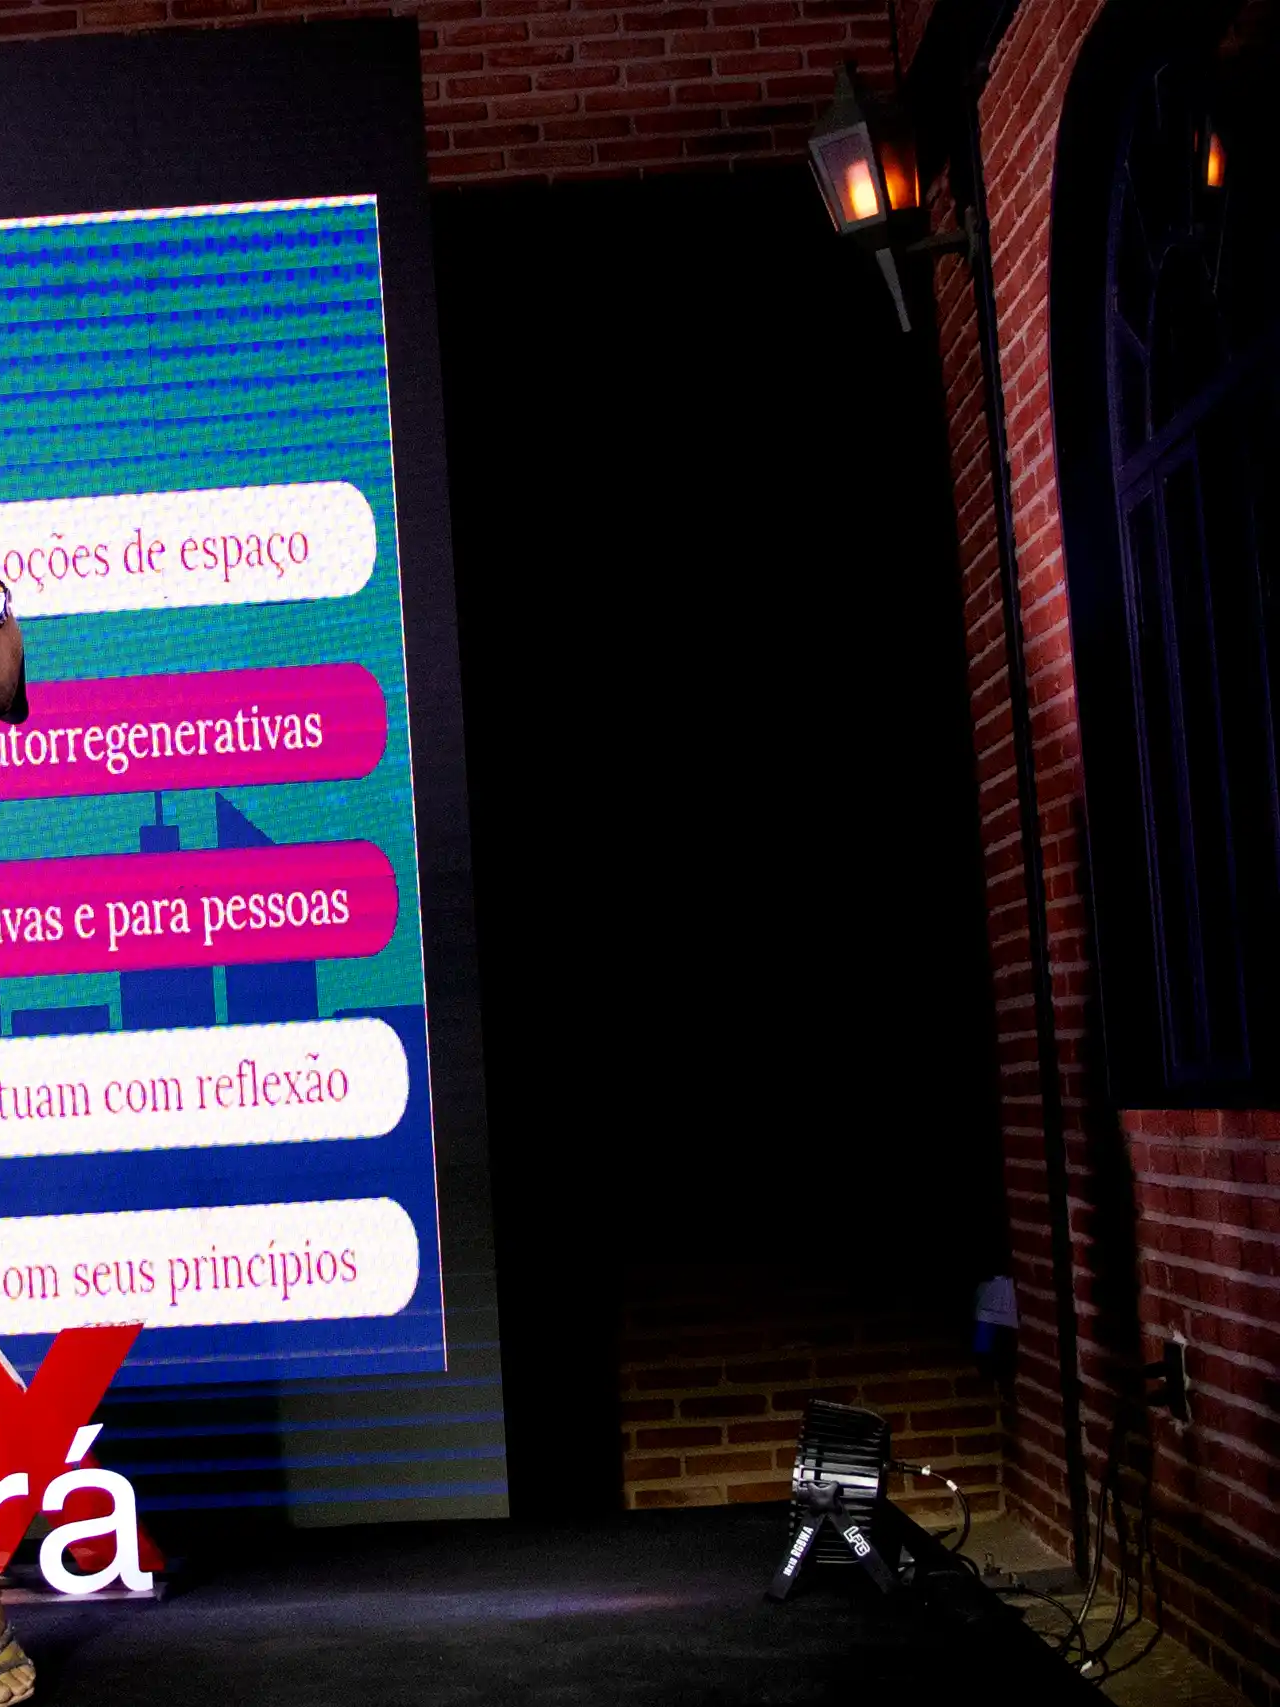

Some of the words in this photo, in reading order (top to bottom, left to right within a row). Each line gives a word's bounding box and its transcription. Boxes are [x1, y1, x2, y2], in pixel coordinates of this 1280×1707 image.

[123, 528, 166, 576] de
[180, 527, 309, 583] espaço
[75, 905, 95, 941] e
[107, 899, 190, 951] para
[203, 886, 350, 946] pessoas
[104, 1075, 184, 1115] com
[196, 1053, 349, 1110] reflexão
[74, 1256, 156, 1299] seus
[170, 1239, 358, 1306] princípios
